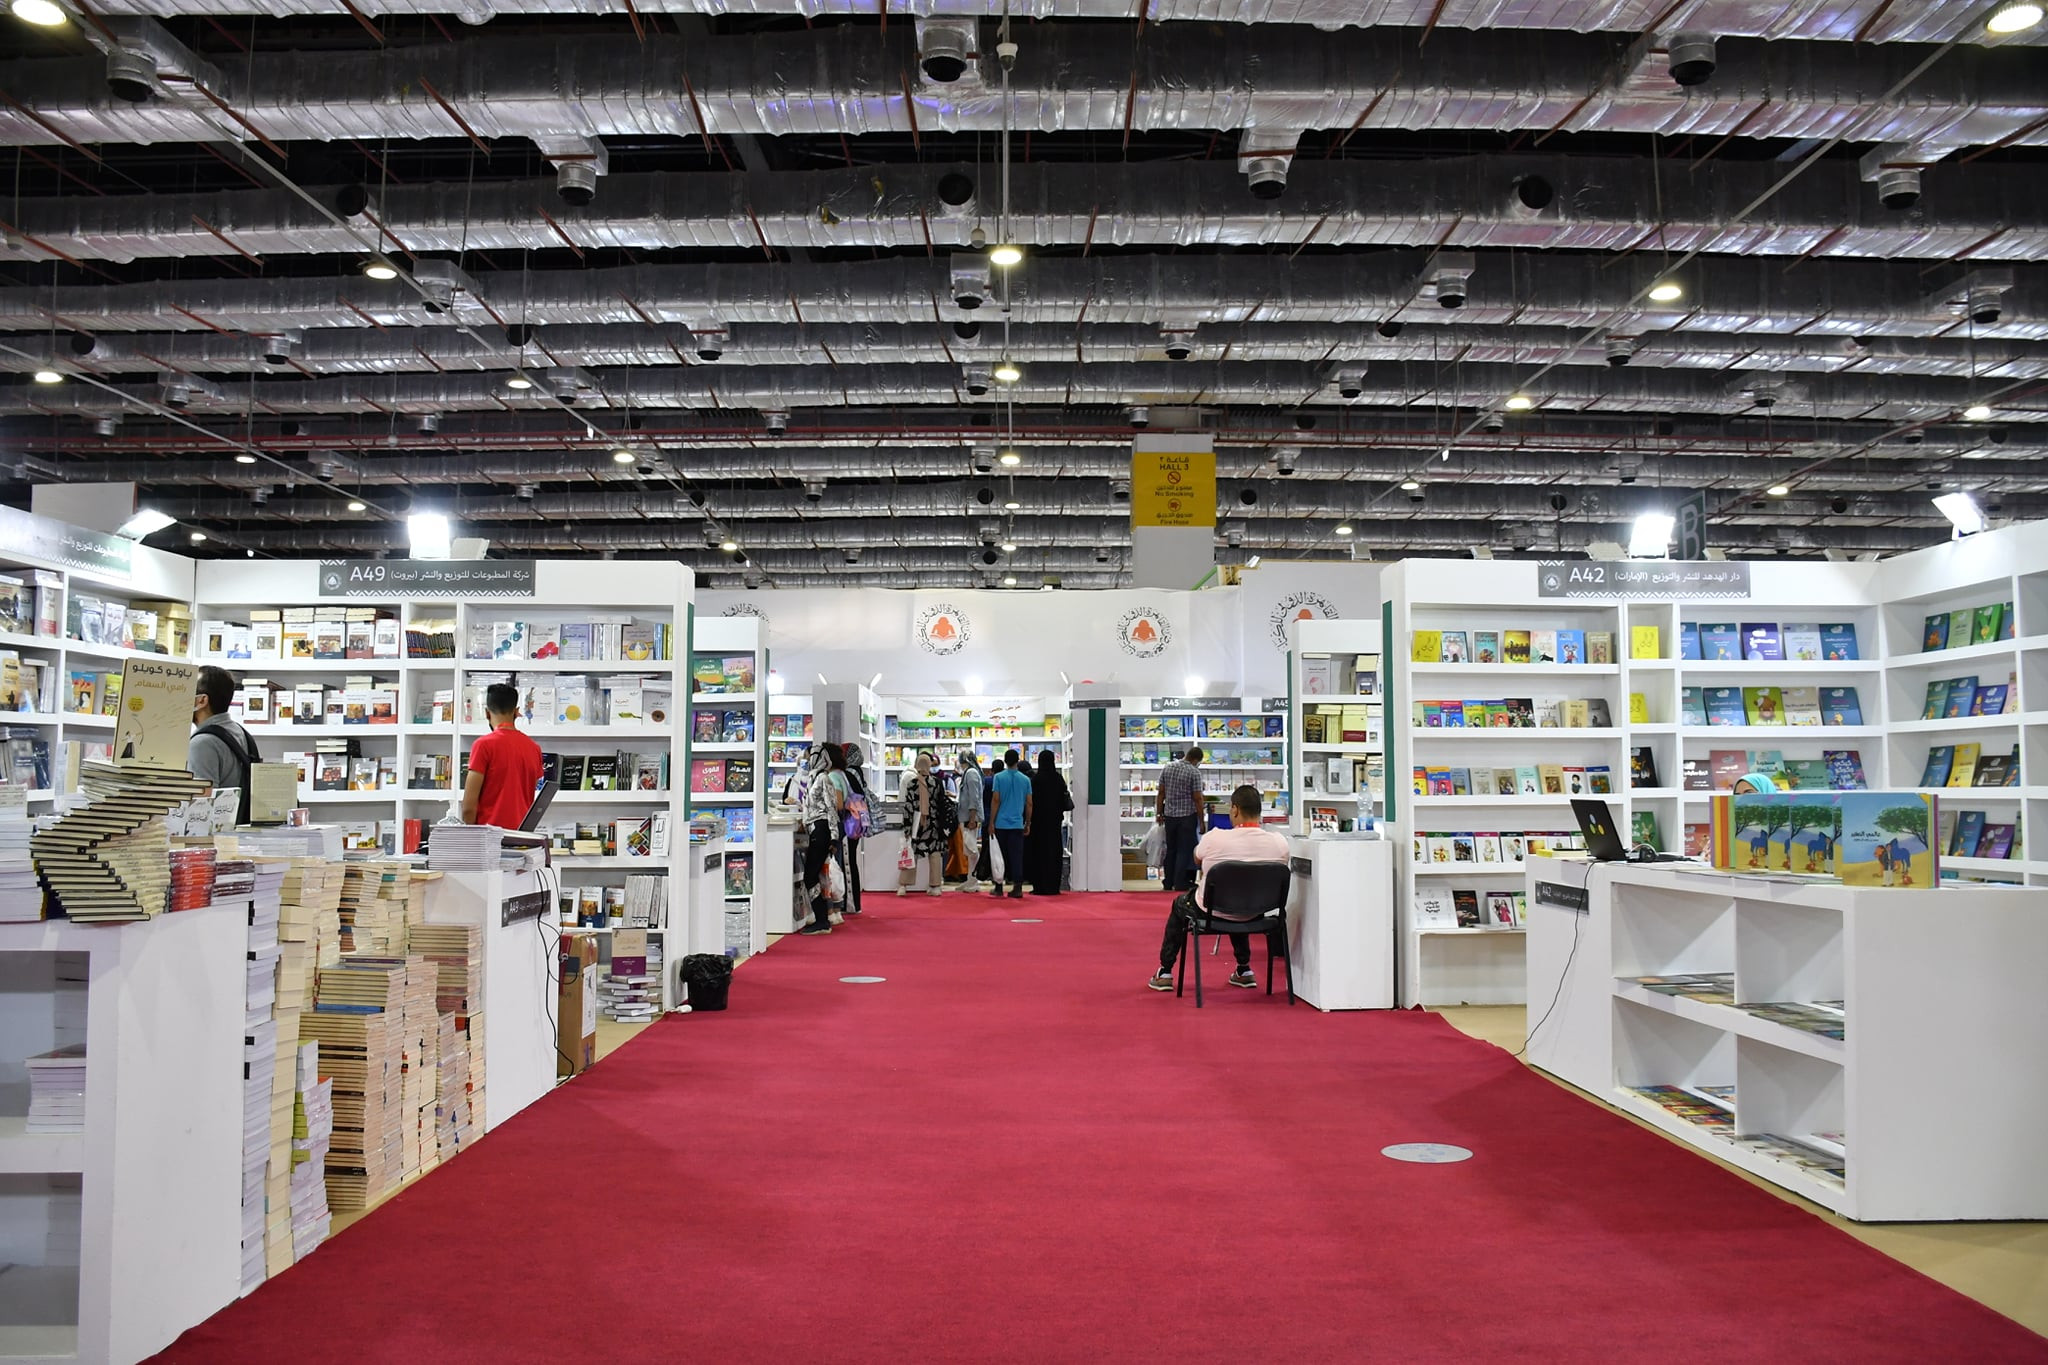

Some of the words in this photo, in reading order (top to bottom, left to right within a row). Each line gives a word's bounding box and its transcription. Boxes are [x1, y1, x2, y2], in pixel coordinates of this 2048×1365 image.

[1159, 463, 1182, 471] HALL
[1183, 463, 1189, 471] 3
[349, 565, 386, 582] A49
[390, 570, 418, 581] (بيروت)
[419, 569, 443, 581] والنشر
[444, 569, 470, 582] للتوزيع
[471, 569, 511, 581] المطبوعات
[513, 570, 530, 580] شركة
[1568, 567, 1605, 583] A42
[1614, 570, 1648, 582] (الإمارات)
[1651, 571, 1681, 583] والتوزيع
[1682, 571, 1701, 582] للنشر
[1701, 571, 1728, 581] الهدهد
[1729, 571, 1741, 582] دار
[132, 663, 164, 675] كويلو
[166, 667, 193, 679] باولو
[134, 679, 166, 689] السهام
[166, 684, 188, 694] رامي
[1163, 699, 1180, 707] A45
[1542, 885, 1552, 897] A42
